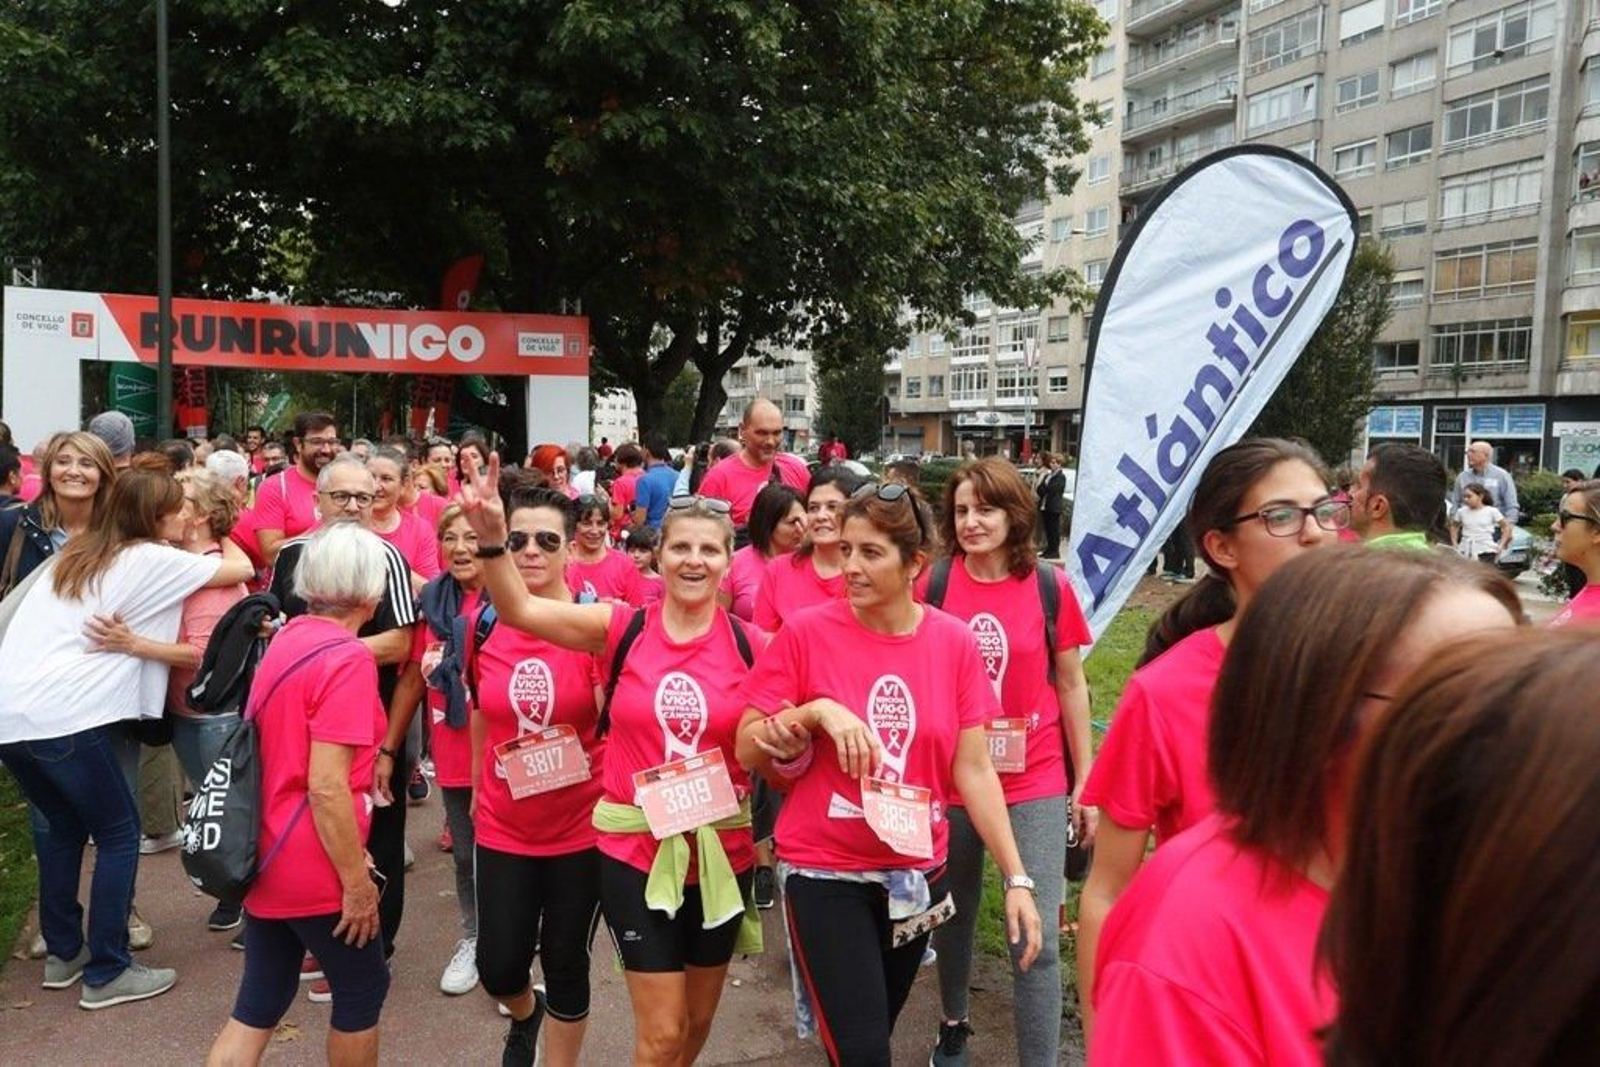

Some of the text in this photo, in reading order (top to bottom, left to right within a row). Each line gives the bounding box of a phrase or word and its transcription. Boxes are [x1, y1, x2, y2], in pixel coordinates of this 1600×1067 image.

[16, 313, 65, 323] CONCELLO
[22, 321, 59, 331] DE VIGO
[521, 336, 561, 344] CONCELLO
[538, 344, 557, 352] VIGO
[1077, 219, 1325, 610] Atlántico
[516, 680, 546, 689] VIGO
[663, 695, 698, 706] VIGO
[875, 703, 907, 715] VIGO
[523, 746, 563, 777] 3817
[660, 776, 713, 814] 3819
[878, 803, 917, 836] 3854
